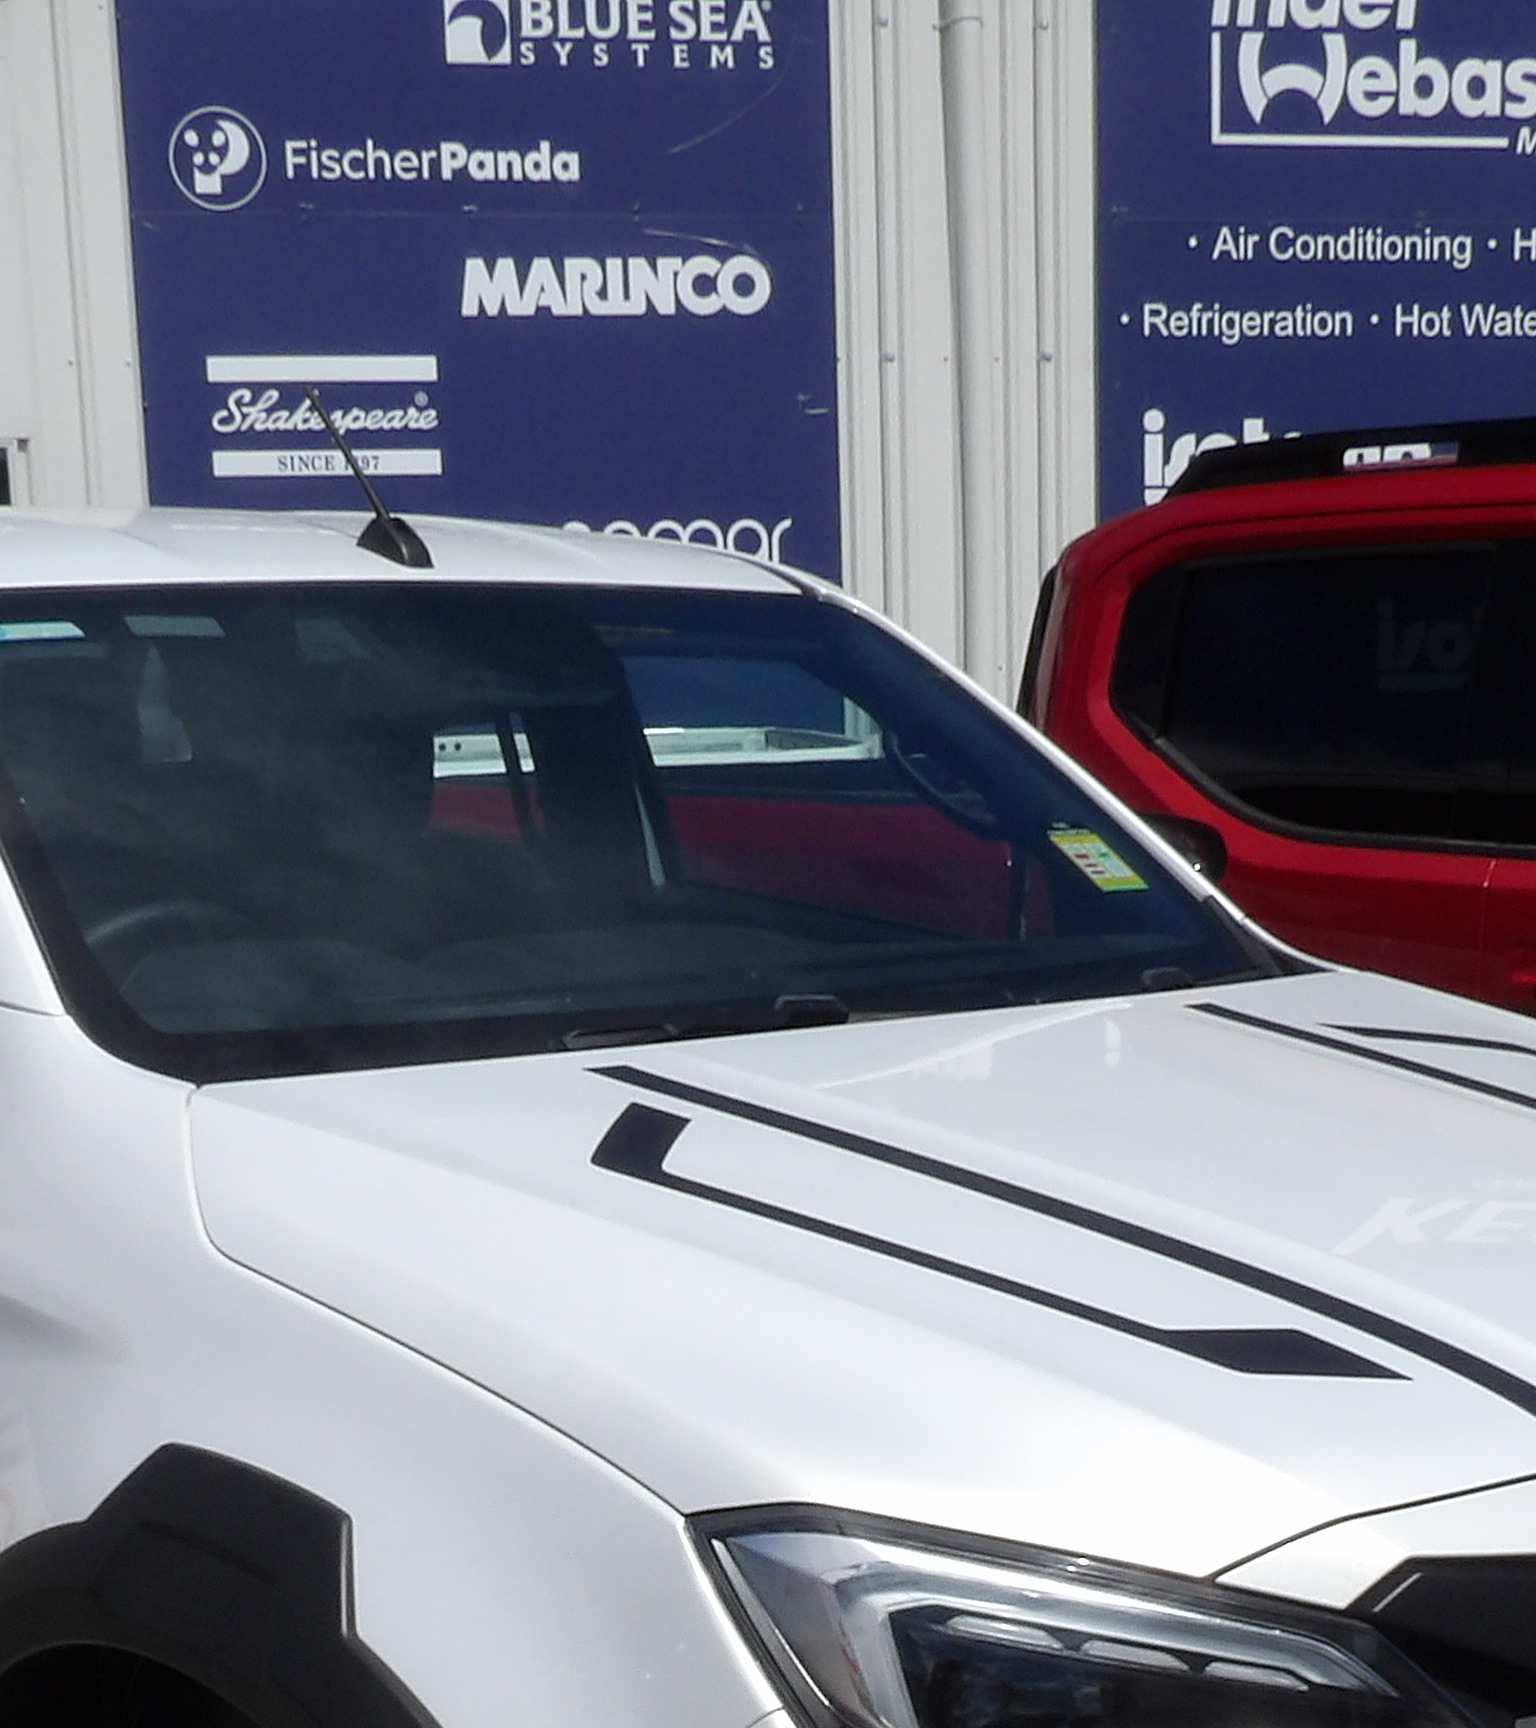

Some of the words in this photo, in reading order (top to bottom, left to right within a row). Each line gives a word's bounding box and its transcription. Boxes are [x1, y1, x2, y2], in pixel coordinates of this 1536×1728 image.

[518, 0, 657, 40] BLUE
[667, 0, 772, 43] SEA
[519, 41, 775, 70] SYSTEMS
[284, 138, 580, 184] FischerPanda
[1212, 227, 1260, 261] Air
[1268, 226, 1472, 271] Conditioning
[461, 255, 772, 318] MARINCO
[1142, 302, 1354, 346] Refrigeration
[1393, 304, 1452, 338] Hot
[277, 454, 336, 473] SINCE
